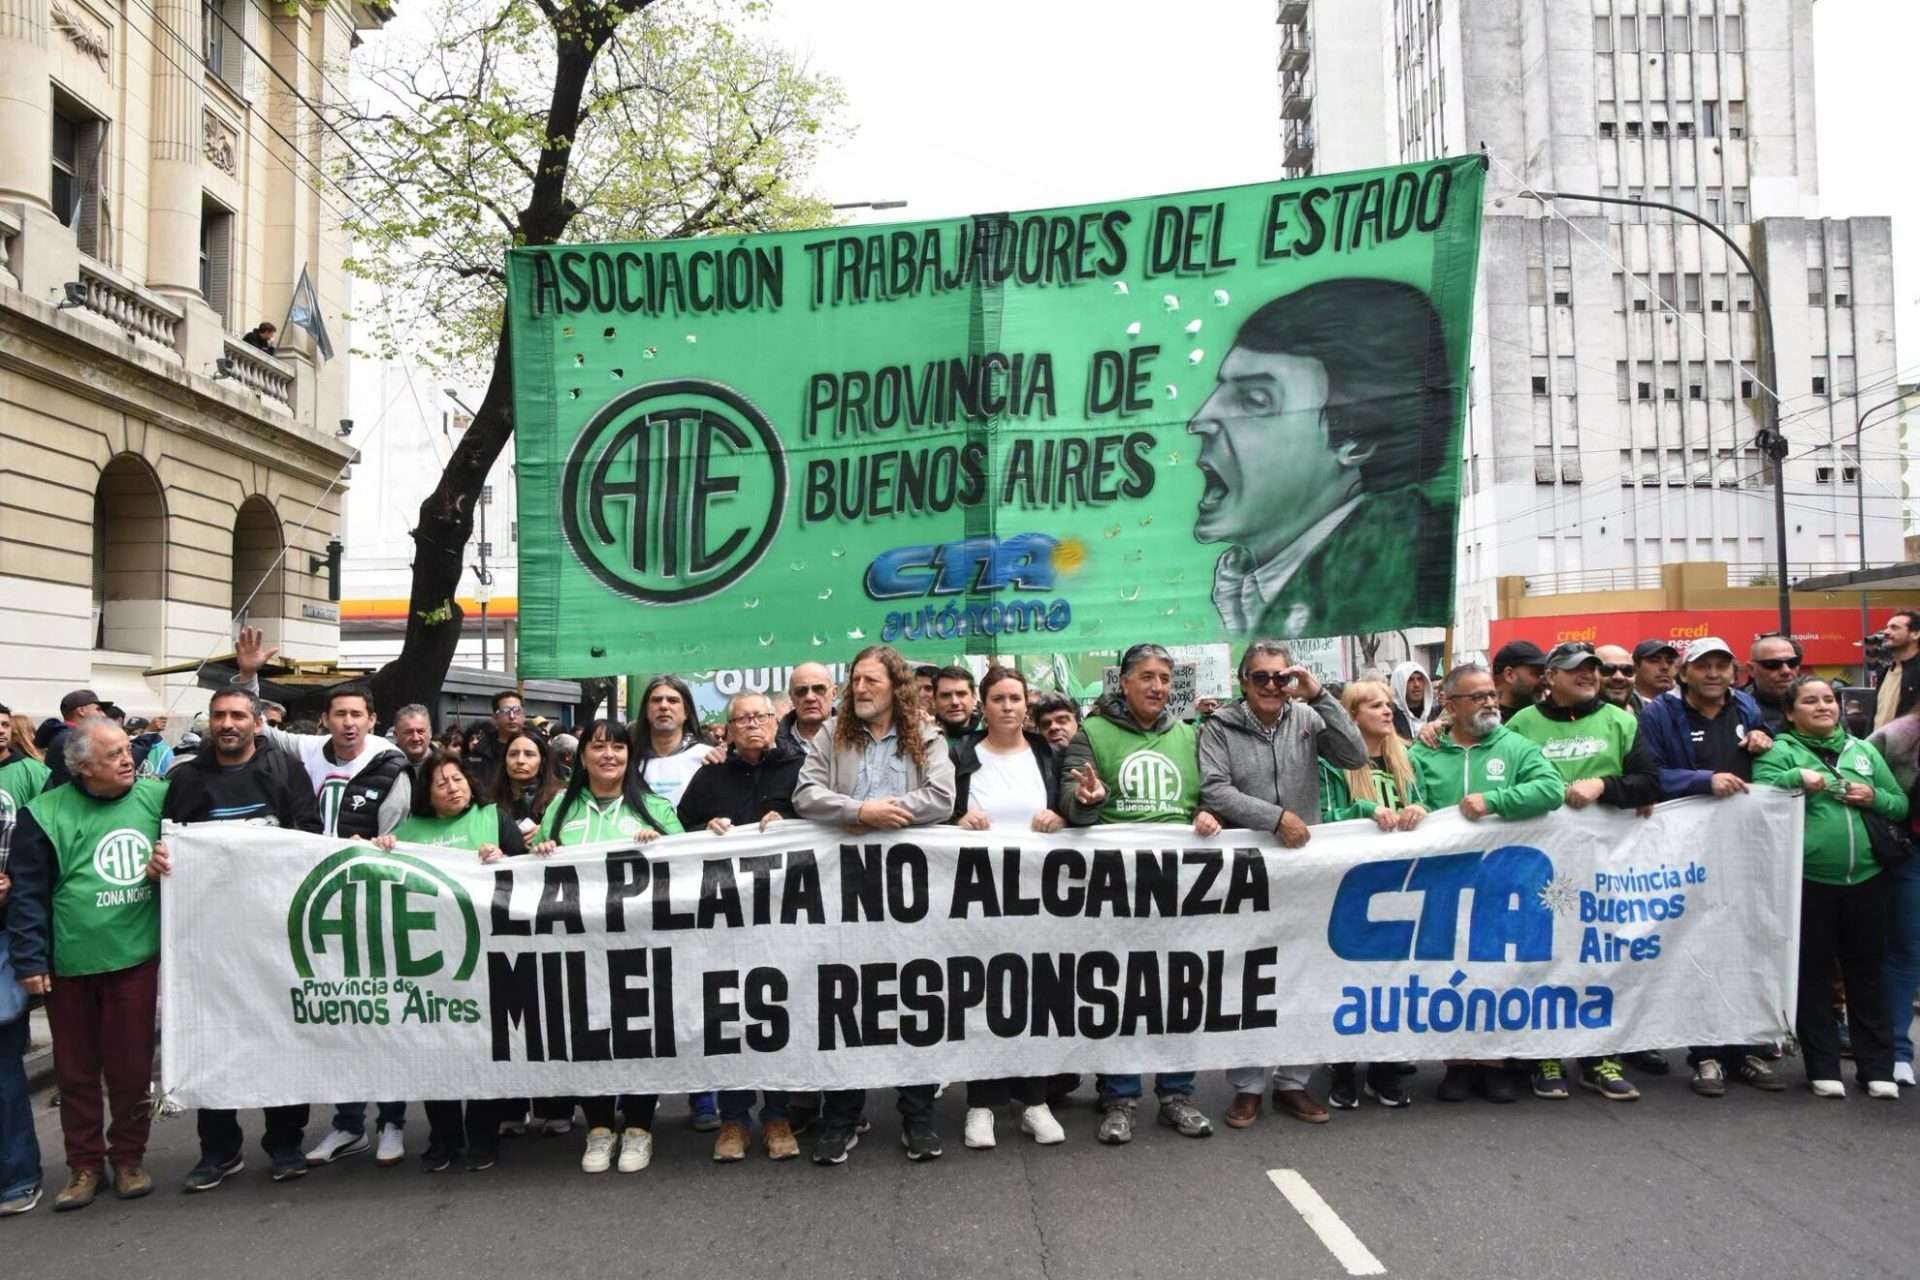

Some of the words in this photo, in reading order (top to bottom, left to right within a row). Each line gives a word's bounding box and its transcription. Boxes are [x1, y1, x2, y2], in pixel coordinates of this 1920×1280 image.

[534, 240, 783, 314] ASOCIACIÓN
[804, 209, 1133, 304] TRABAJADORES
[1151, 203, 1237, 274] DEL
[1263, 164, 1453, 261] ESTADO
[807, 352, 1056, 438] PROVINCIA
[1089, 345, 1161, 415] DE
[588, 408, 754, 579] ATE
[806, 442, 988, 524] BUENOS
[1004, 432, 1158, 505] AIRES
[864, 532, 1056, 601] CTA
[1557, 626, 1597, 641] credi
[1669, 623, 1709, 638] credi
[1123, 755, 1176, 800] ATE
[1116, 799, 1157, 812] Buenos
[100, 834, 148, 879] ATE
[1595, 864, 1682, 894] Provincia
[1685, 861, 1707, 885] de
[96, 889, 126, 908] ZONA
[489, 865, 585, 937] LA
[604, 848, 826, 934] PLATA
[839, 842, 930, 924] NO
[948, 846, 1271, 919] ALCANZA
[1327, 844, 1555, 963] CTA
[1579, 890, 1686, 924] Buenos
[308, 862, 444, 978] ATE
[1579, 926, 1662, 963] Aires
[289, 987, 391, 1026] Buenos
[401, 985, 481, 1025] Aires
[303, 977, 389, 998] Provincia
[393, 978, 414, 994] de
[487, 946, 678, 1063] MILEI
[702, 965, 791, 1057] ES
[817, 946, 1279, 1052] RESPONSABLE
[1332, 968, 1615, 1036] autónoma
